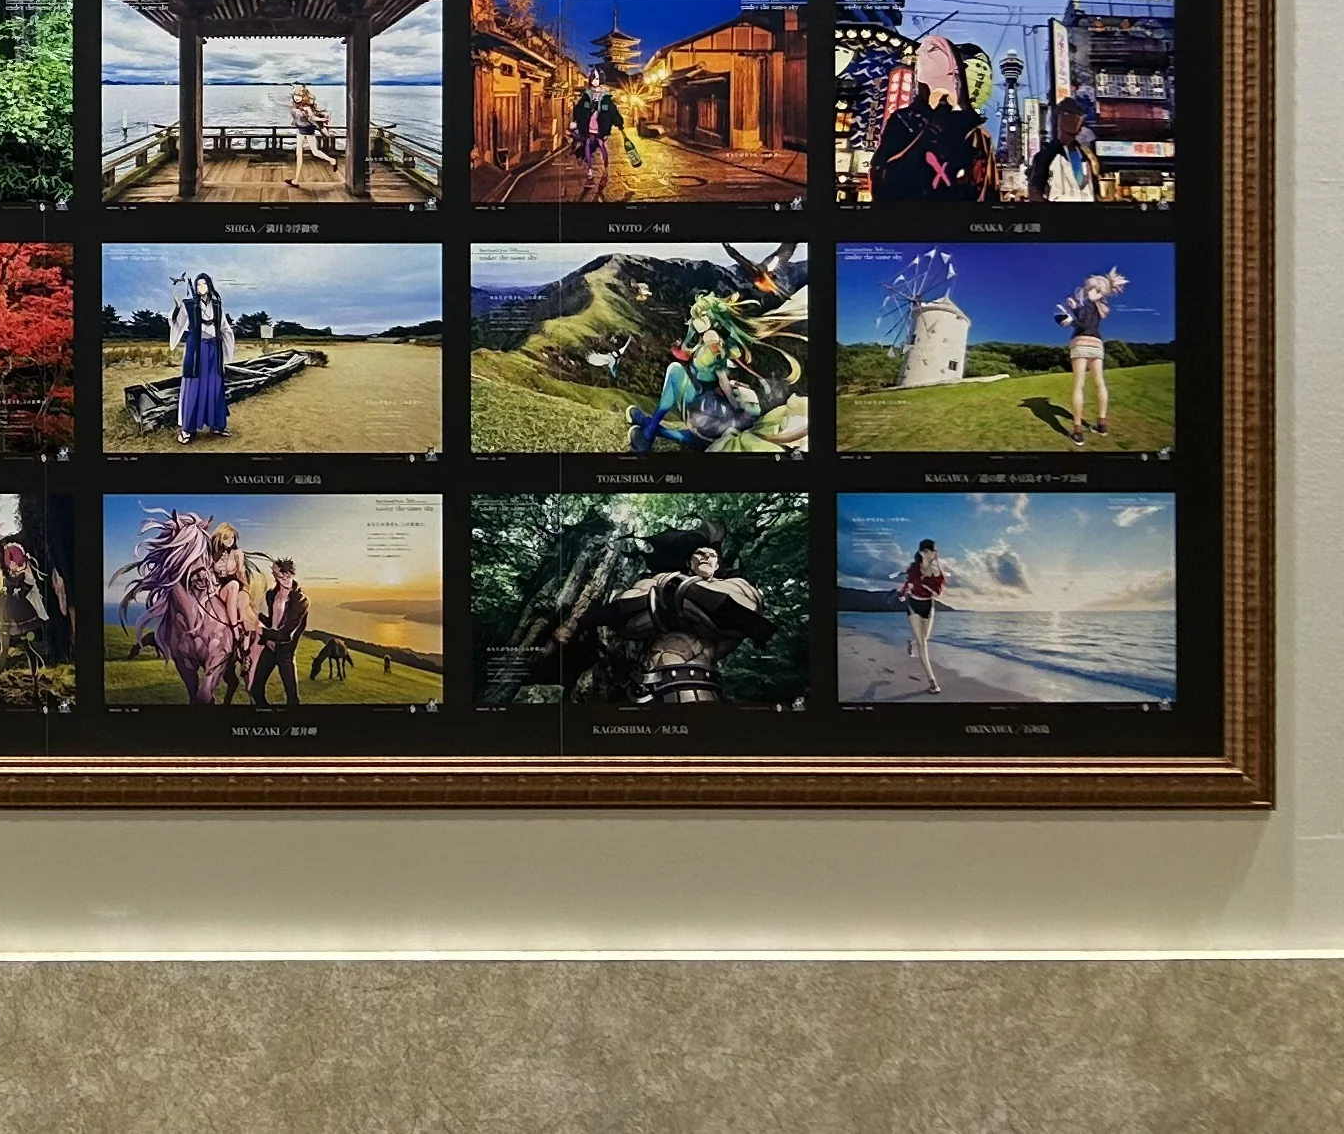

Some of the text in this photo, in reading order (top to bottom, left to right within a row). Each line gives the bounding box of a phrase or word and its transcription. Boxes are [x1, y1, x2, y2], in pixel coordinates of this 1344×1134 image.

[224, 224, 256, 233] SHIGA
[608, 223, 643, 233] KYOTO
[969, 223, 1004, 232] OSAKA
[224, 475, 285, 484] YAMAGUCHI
[596, 474, 655, 484] TOKUSHIMA
[231, 727, 281, 736] MIYAZAKI
[592, 725, 652, 735] KAGOSHIMA
